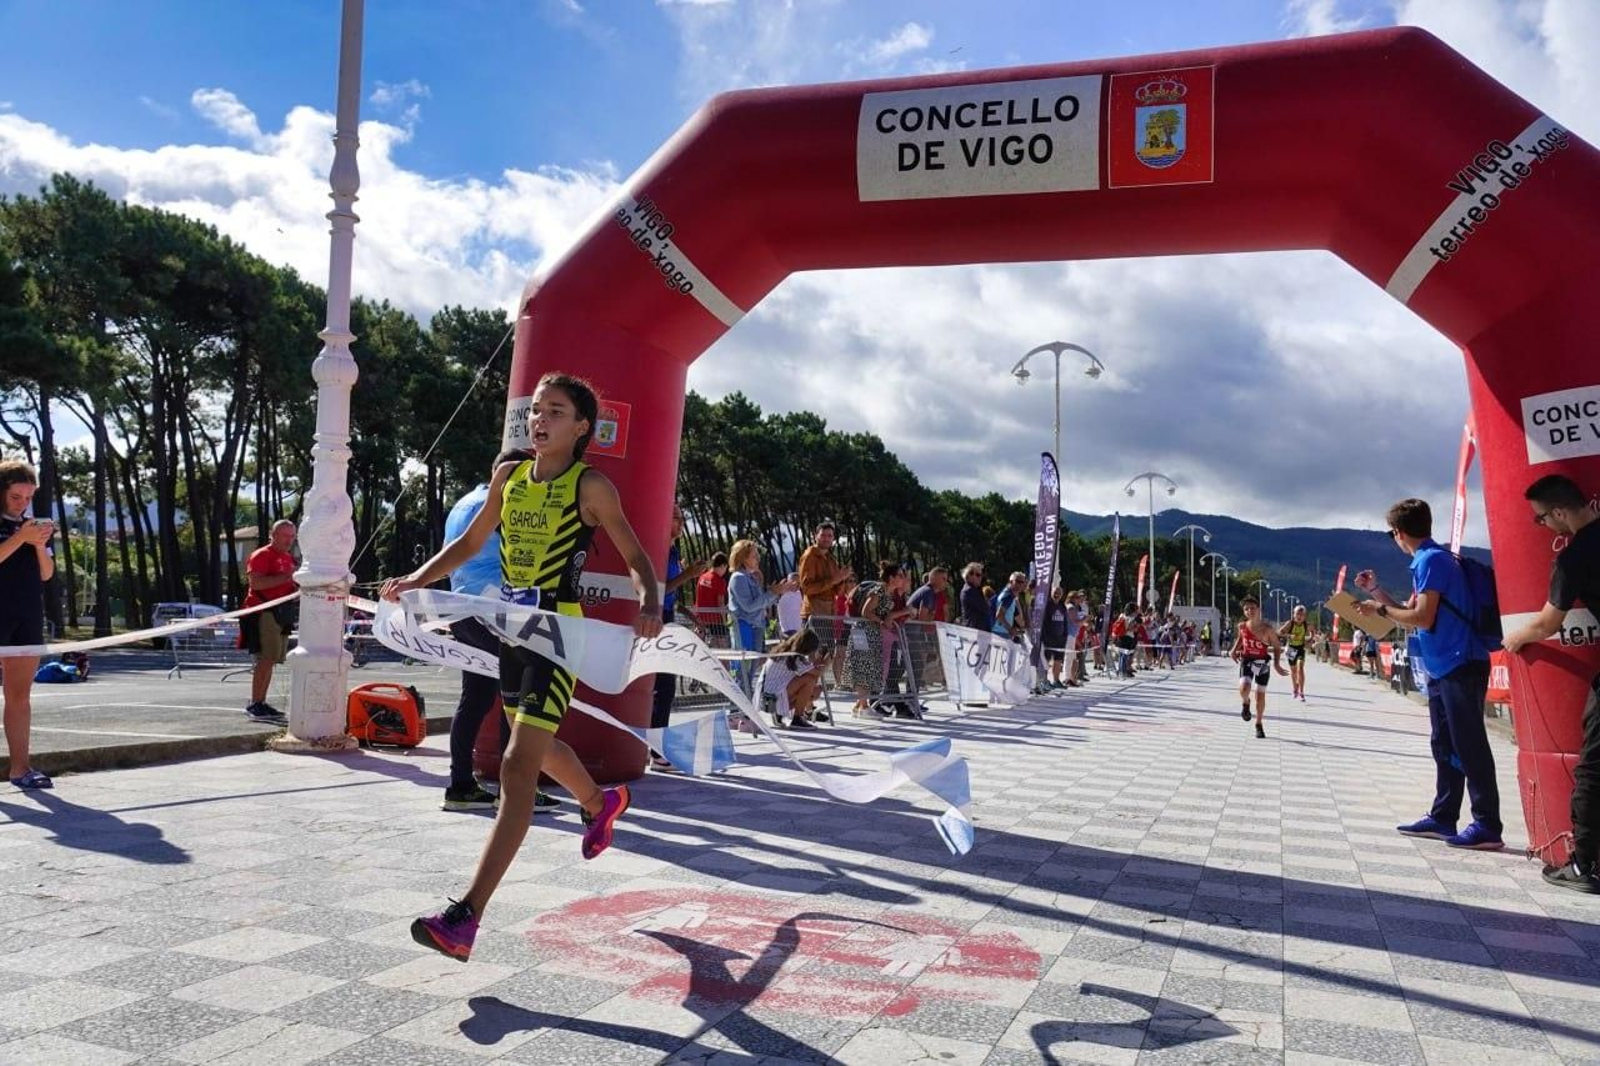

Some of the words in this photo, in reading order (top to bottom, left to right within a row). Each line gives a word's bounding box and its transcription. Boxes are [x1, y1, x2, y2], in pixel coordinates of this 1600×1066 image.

[875, 94, 1080, 134] CONCELLO
[898, 140, 945, 172] DE
[960, 133, 1053, 168] VIGO
[1448, 140, 1524, 197] VIGO,
[1429, 193, 1500, 262] terreo
[1499, 161, 1531, 190] de
[630, 227, 652, 250] de
[652, 251, 694, 294] xogo
[1532, 400, 1599, 426] CONC
[1549, 425, 1581, 445] DE
[509, 509, 548, 529] GARCÍA
[1560, 625, 1598, 647] ter
